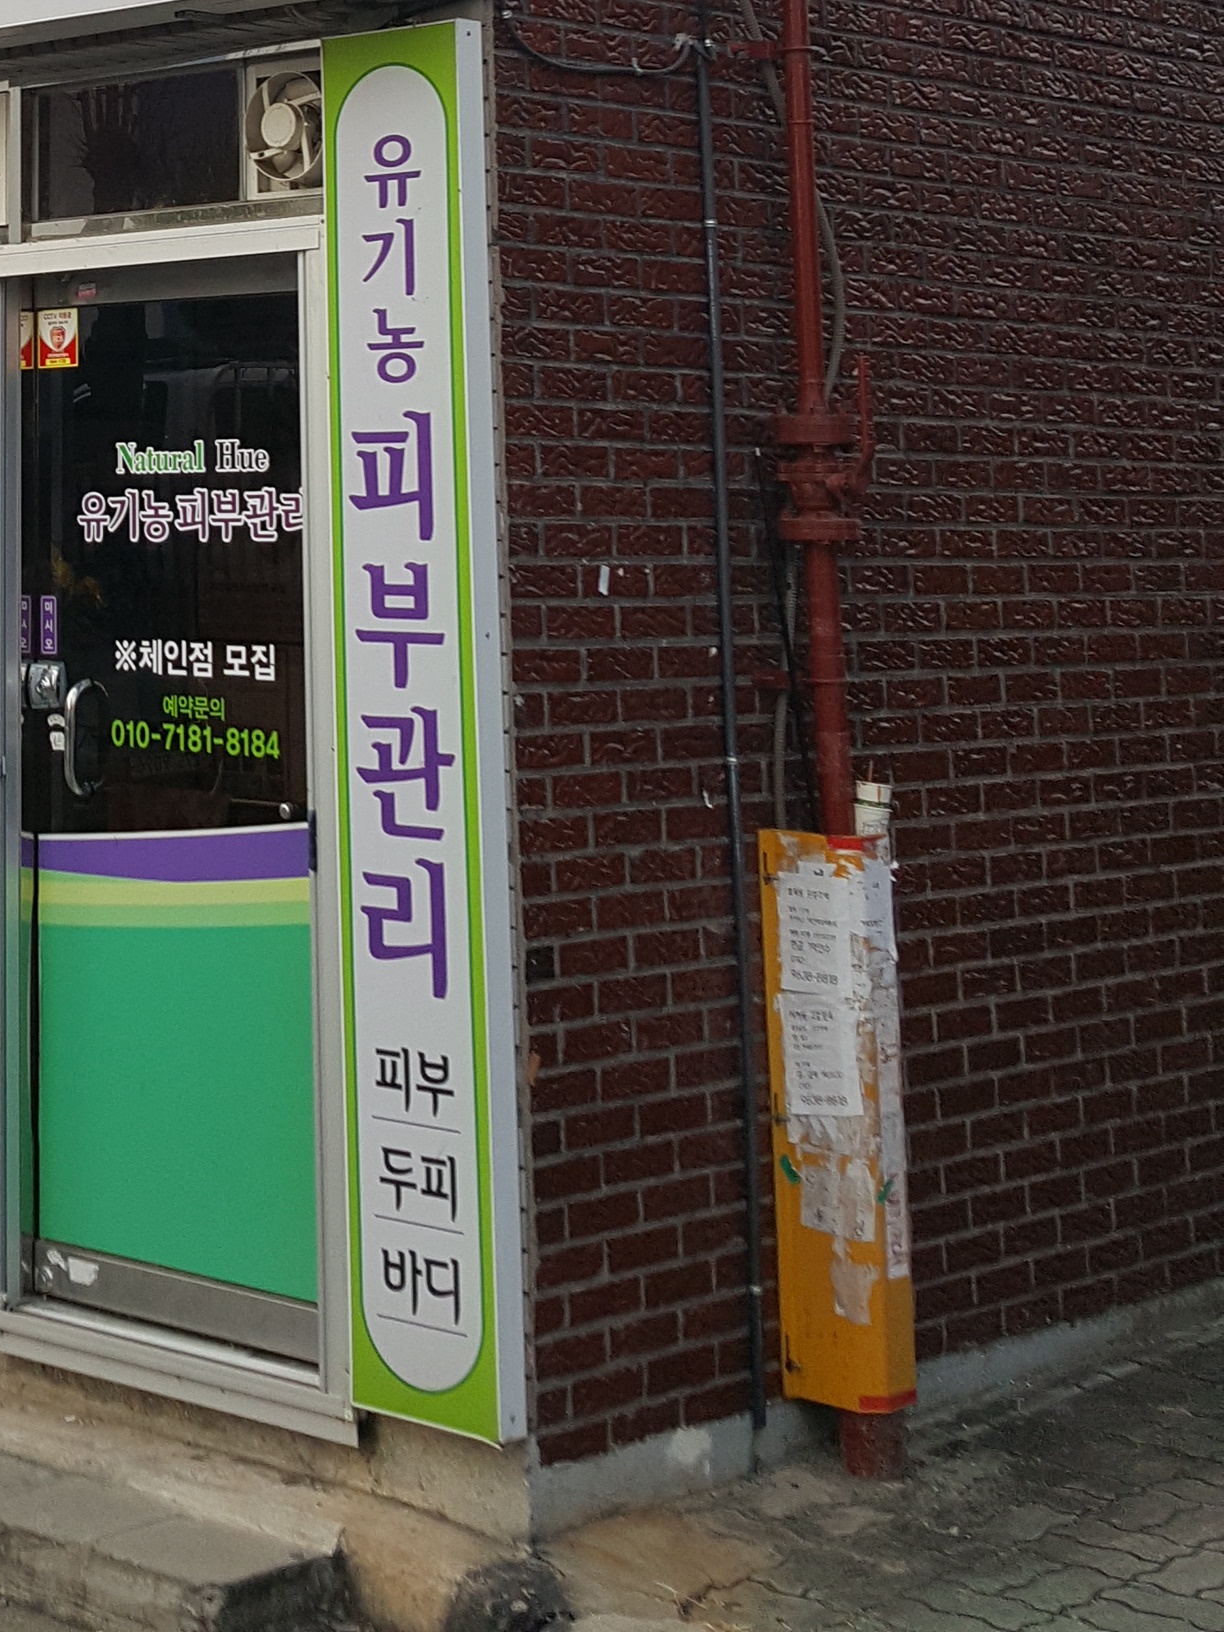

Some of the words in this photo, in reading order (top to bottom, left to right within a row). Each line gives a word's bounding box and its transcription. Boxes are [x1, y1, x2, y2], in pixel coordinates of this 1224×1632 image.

[115, 439, 207, 475] Natural
[215, 438, 270, 473] Hue
[138, 638, 214, 678] 체인점
[223, 643, 276, 682] 모집
[162, 694, 226, 722] 예약문의
[111, 718, 281, 760] 010-7181-8184
[374, 1046, 455, 1117] 피부
[378, 1146, 458, 1222] 두피
[382, 1248, 462, 1325] 바디
